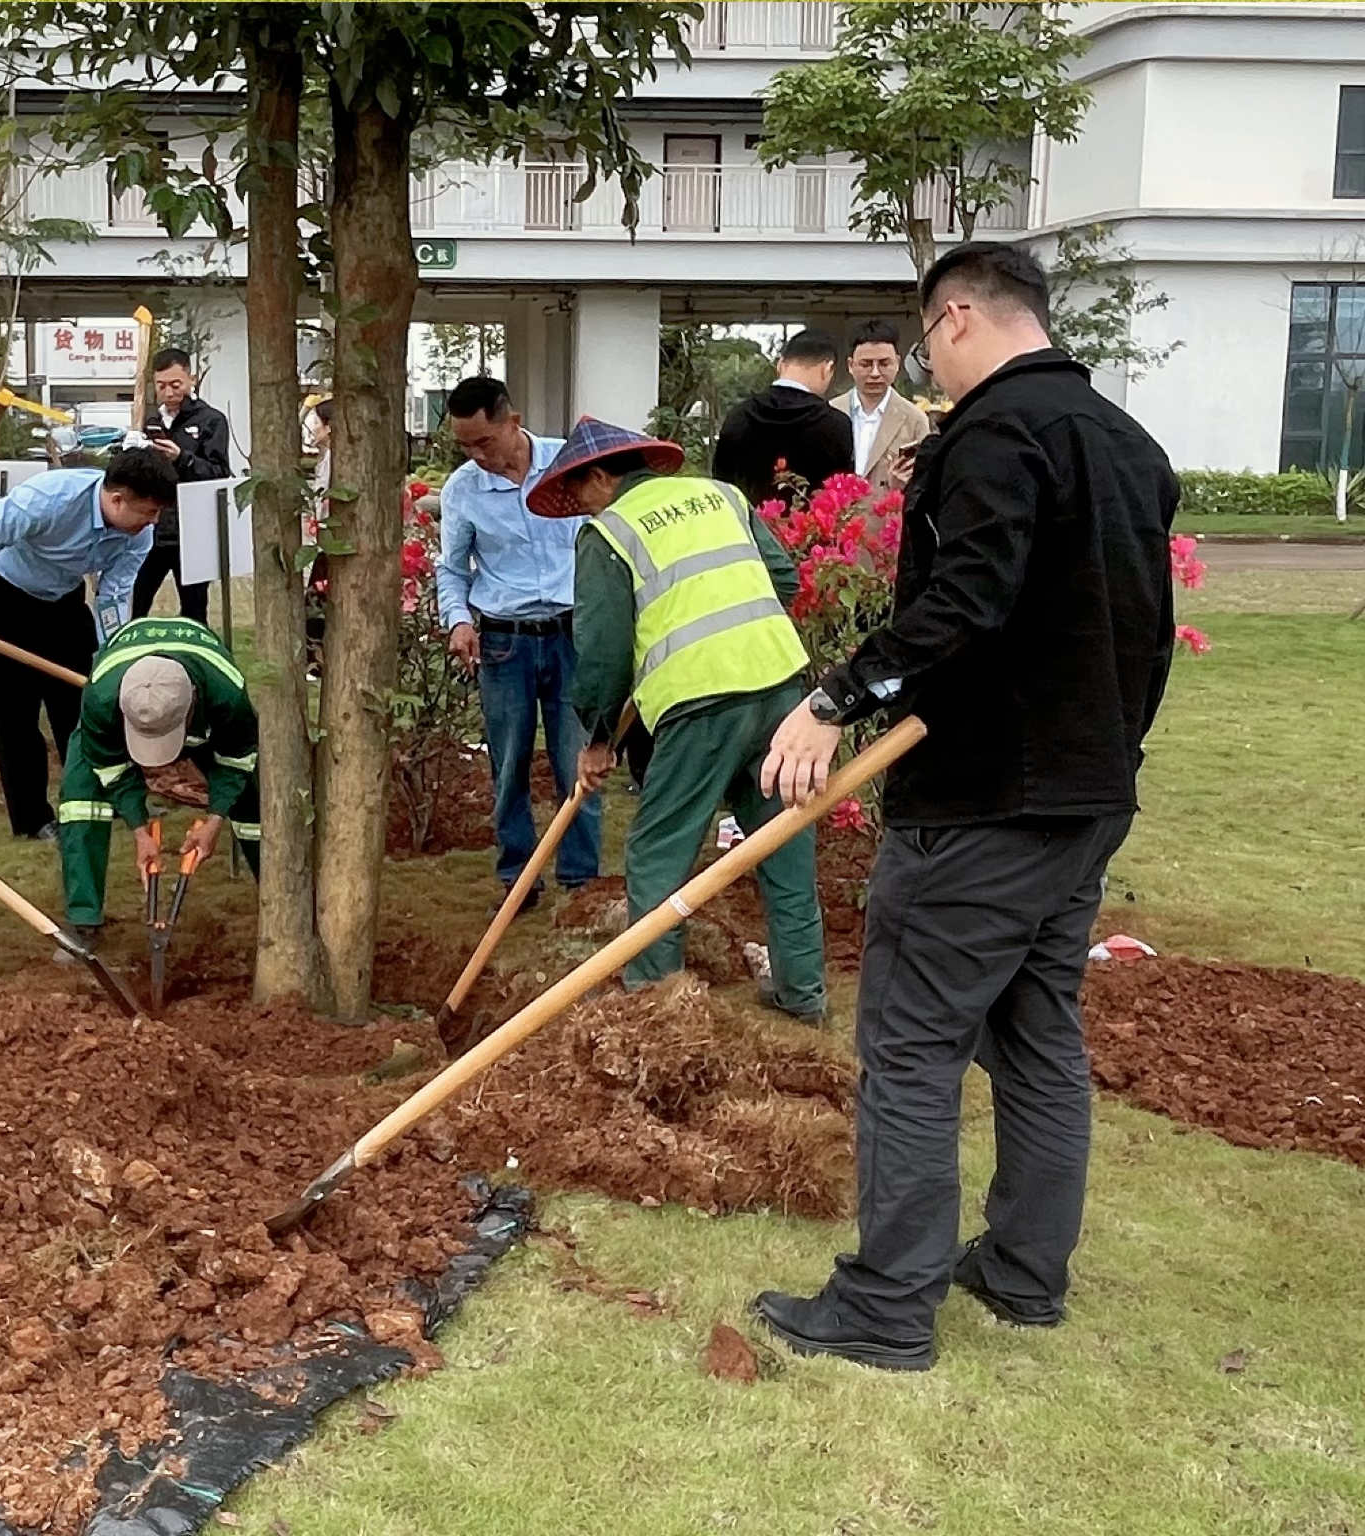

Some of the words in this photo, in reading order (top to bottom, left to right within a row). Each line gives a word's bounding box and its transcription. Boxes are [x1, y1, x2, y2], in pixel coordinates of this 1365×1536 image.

[54, 328, 134, 351] 货物出
[69, 354, 96, 364] Cargo
[639, 493, 724, 534] 园林养护
